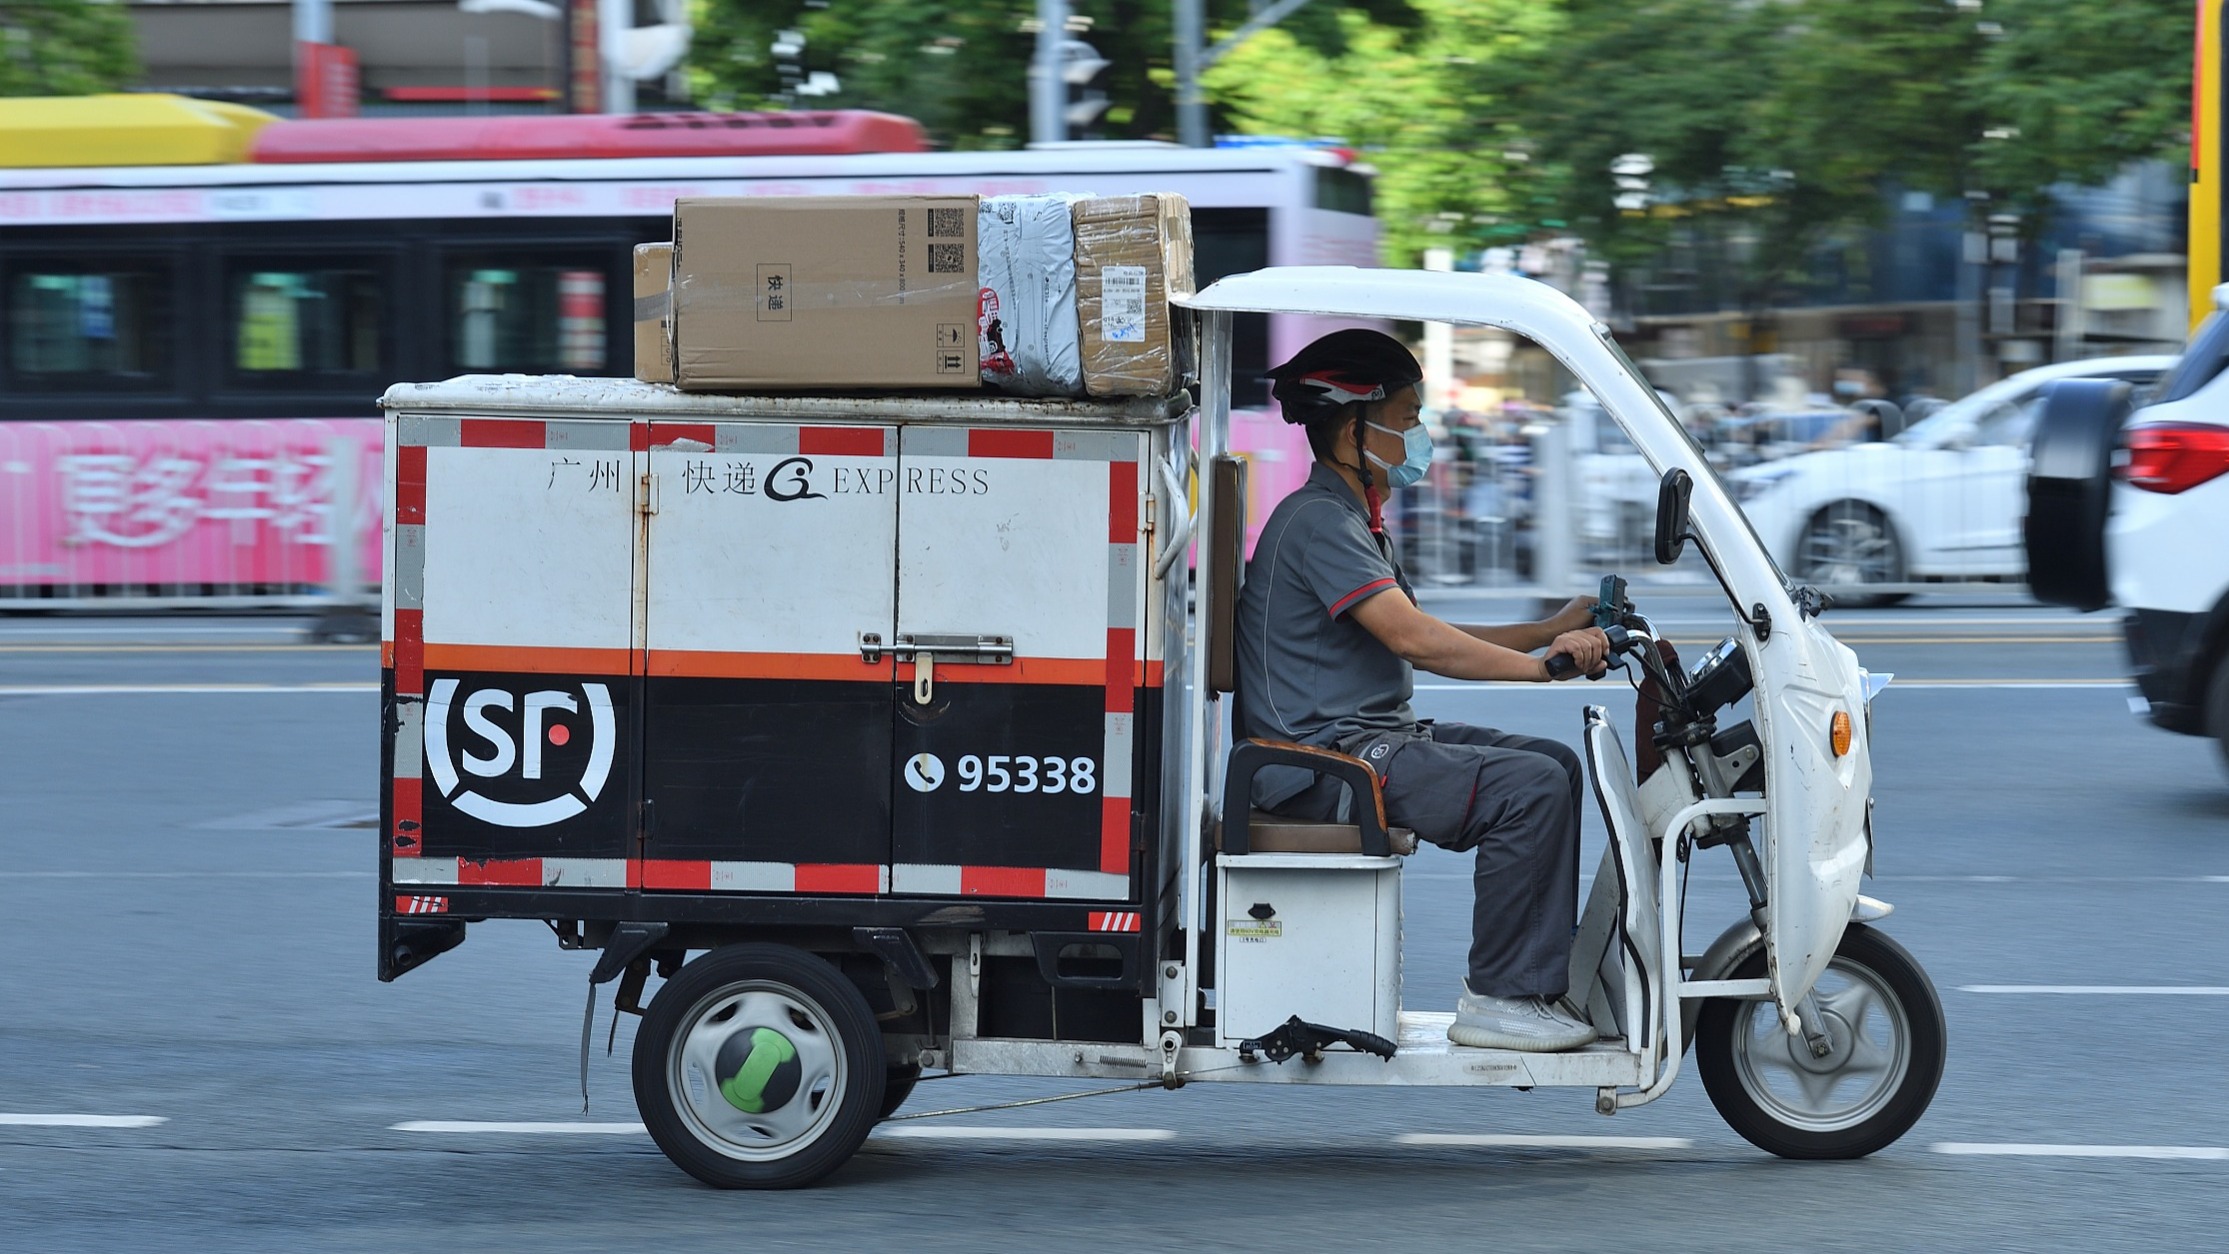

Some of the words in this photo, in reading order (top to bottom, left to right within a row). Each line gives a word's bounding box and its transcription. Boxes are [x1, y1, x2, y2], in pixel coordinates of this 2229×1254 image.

[767, 275, 784, 311] 快递
[547, 457, 620, 493] 广州
[682, 460, 758, 495] 快递
[833, 467, 990, 495] EXPRESS
[957, 754, 1096, 794] 95338
